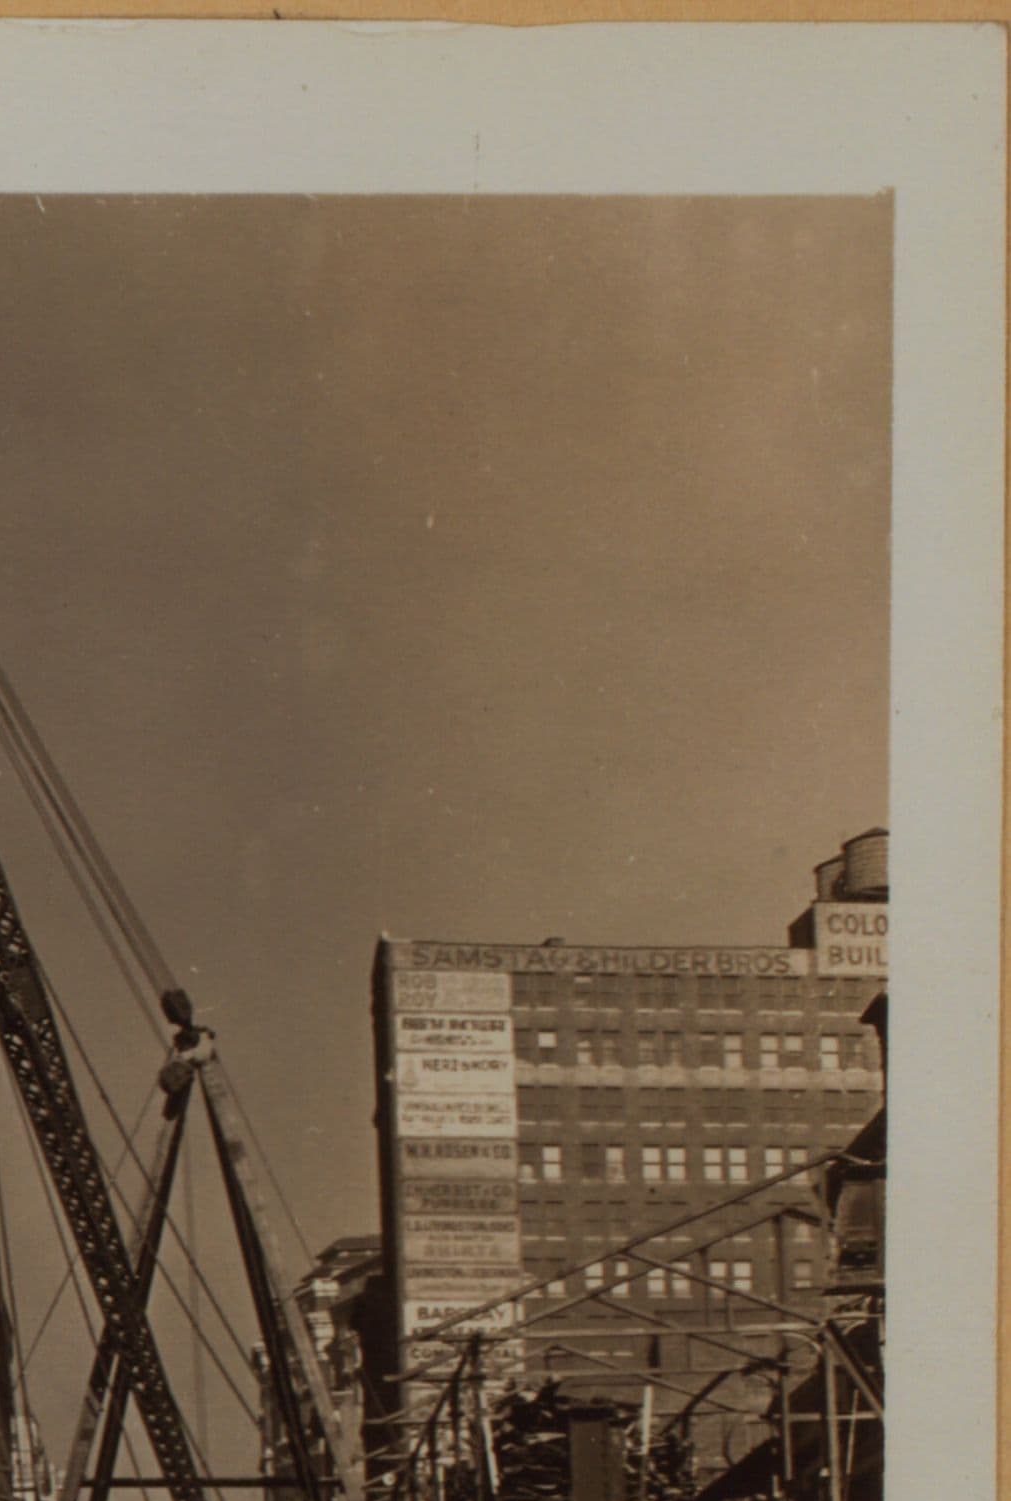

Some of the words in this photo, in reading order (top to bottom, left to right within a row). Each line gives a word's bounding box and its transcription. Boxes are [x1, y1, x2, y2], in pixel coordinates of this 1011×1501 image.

[827, 912, 889, 936] COLO
[411, 948, 570, 971] SAMSTAG
[716, 952, 792, 975] BROS
[828, 945, 889, 967] BUIL
[416, 1306, 507, 1321] BARAY
